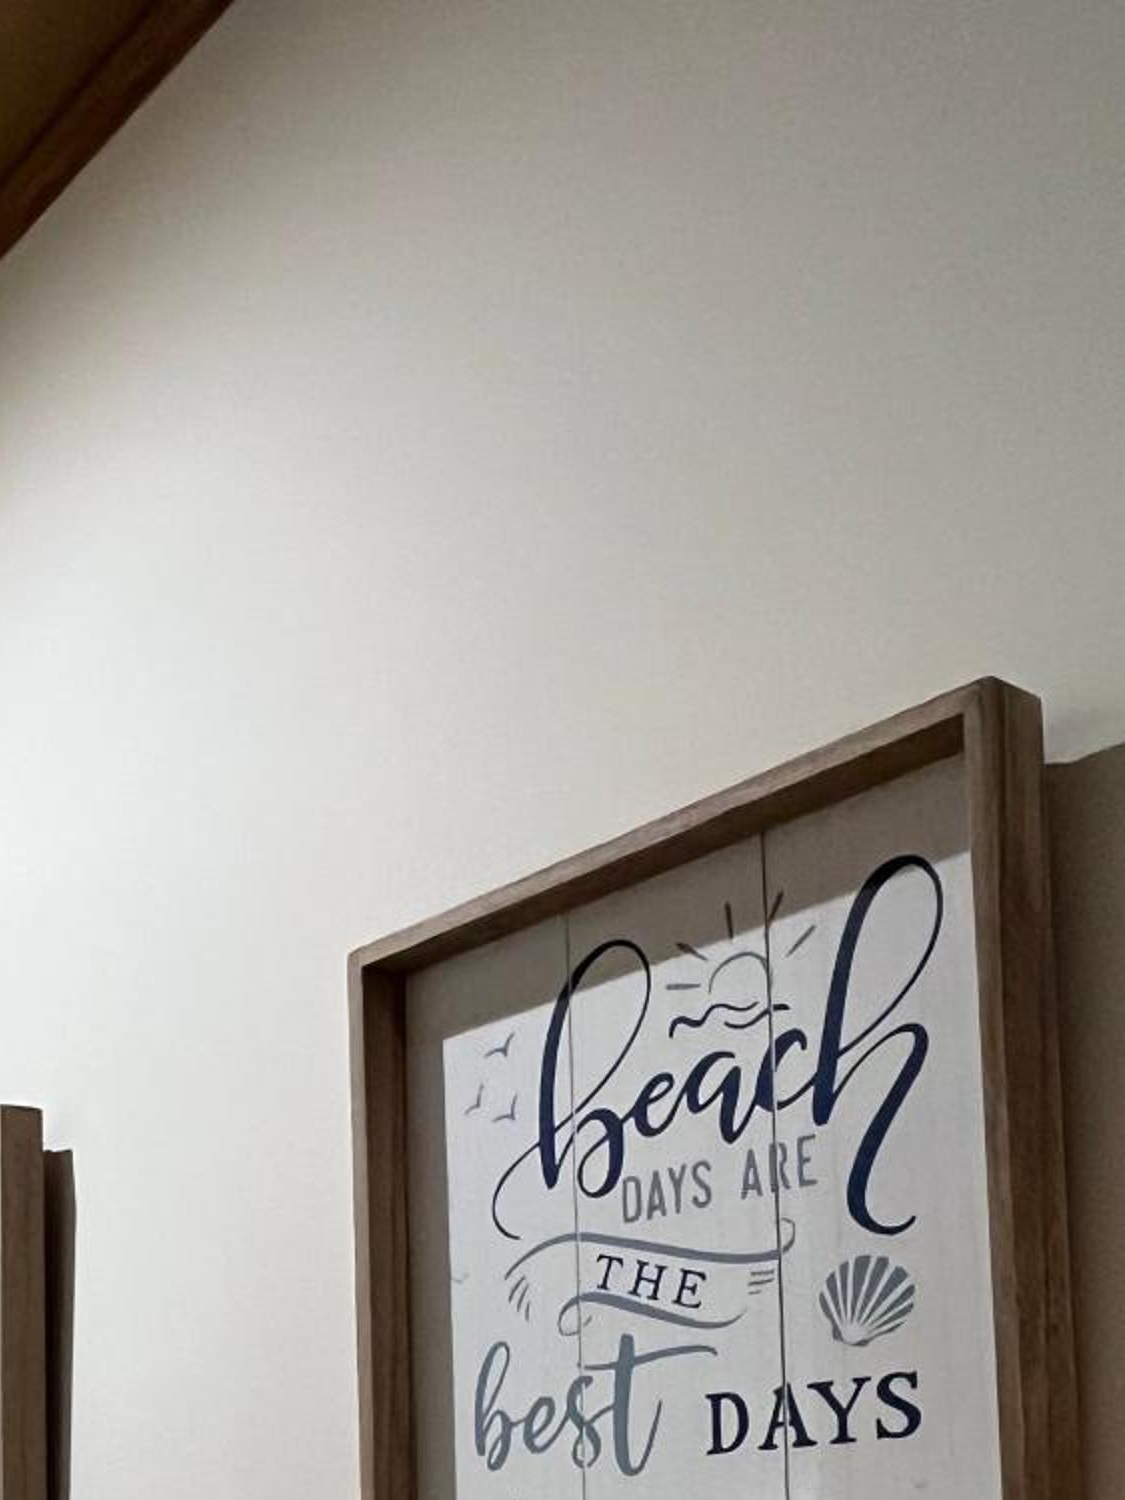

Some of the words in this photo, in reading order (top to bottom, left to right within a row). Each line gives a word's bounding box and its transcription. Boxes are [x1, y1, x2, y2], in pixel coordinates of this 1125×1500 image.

[492, 854, 944, 1237] beach
[621, 1159, 713, 1224] DAYS
[740, 1134, 819, 1200] ARE
[594, 1253, 708, 1309] THE
[475, 1333, 718, 1477] best
[704, 1370, 923, 1456] DAYS
